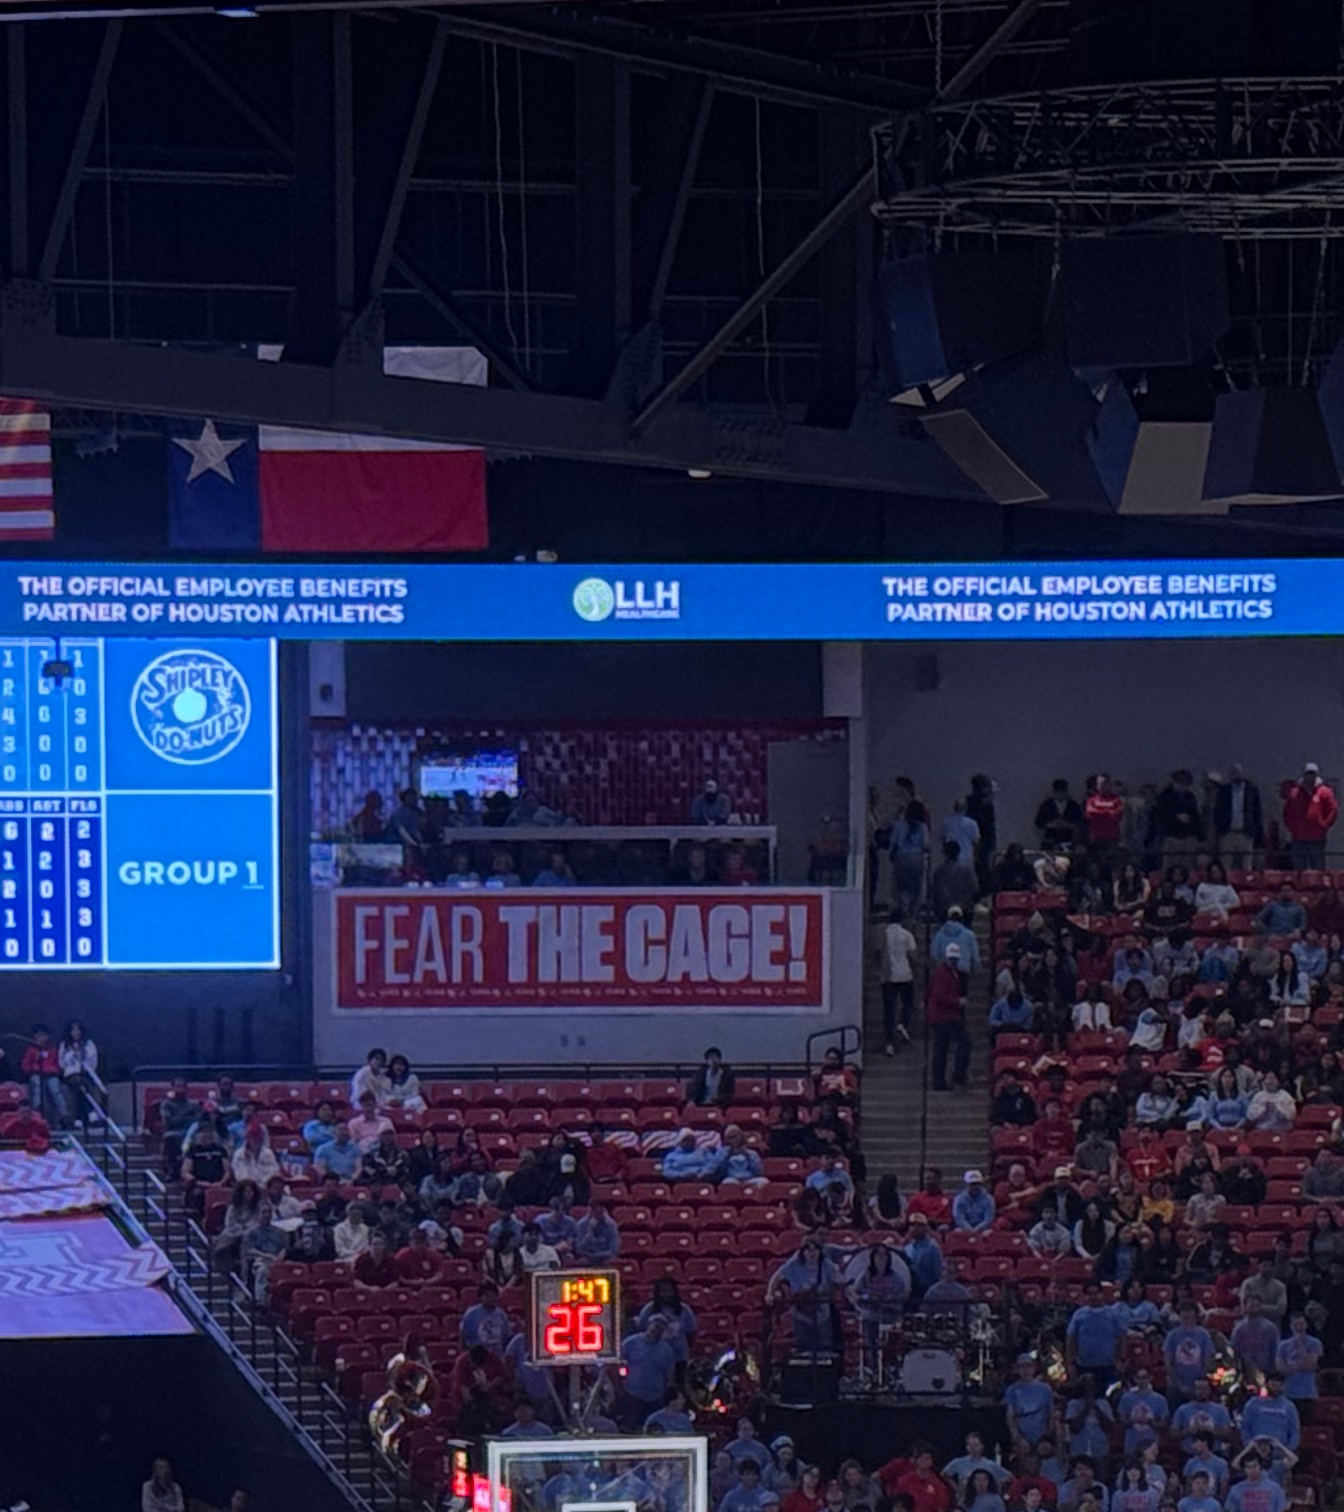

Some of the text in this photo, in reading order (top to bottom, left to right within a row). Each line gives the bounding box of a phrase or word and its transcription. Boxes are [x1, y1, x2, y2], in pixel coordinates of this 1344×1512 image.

[18, 576, 408, 598] THE OFFICIAL EMPLOYEE BENEFITS
[616, 580, 680, 609] LLH
[882, 574, 1277, 597] THE OFFICIAL EMPLOYEE BENEFITS
[23, 603, 405, 624] PARTNER OF HOUSTON ATHLETICS
[886, 599, 1273, 622] PARTNER OF HOUSTON ATHLETICS
[4, 650, 14, 667] 1
[73, 650, 83, 668] 1
[3, 679, 14, 696] 2
[73, 679, 86, 696] 0
[141, 660, 234, 703] SHIPLEY
[2, 707, 16, 725] 4
[75, 708, 86, 725] 3
[4, 736, 16, 753] 3
[39, 735, 51, 752] 0
[75, 737, 87, 753] 0
[4, 765, 16, 782] 0
[40, 764, 51, 781] 0
[41, 822, 54, 841] 2
[77, 820, 91, 839] 2
[3, 852, 15, 870] 1
[39, 852, 52, 870] 2
[78, 850, 91, 868] 3
[119, 862, 263, 888] GROUP 1
[40, 881, 53, 898] 0
[77, 879, 90, 898] 3
[5, 909, 16, 928] 1
[41, 910, 52, 929] 1
[78, 908, 92, 927] 3
[6, 939, 19, 958] 0
[41, 939, 55, 957] 0
[78, 938, 91, 956] 0
[355, 904, 808, 984] FEAR THE CAGE!
[563, 1278, 609, 1303] 1:47
[546, 1304, 602, 1352] 26
